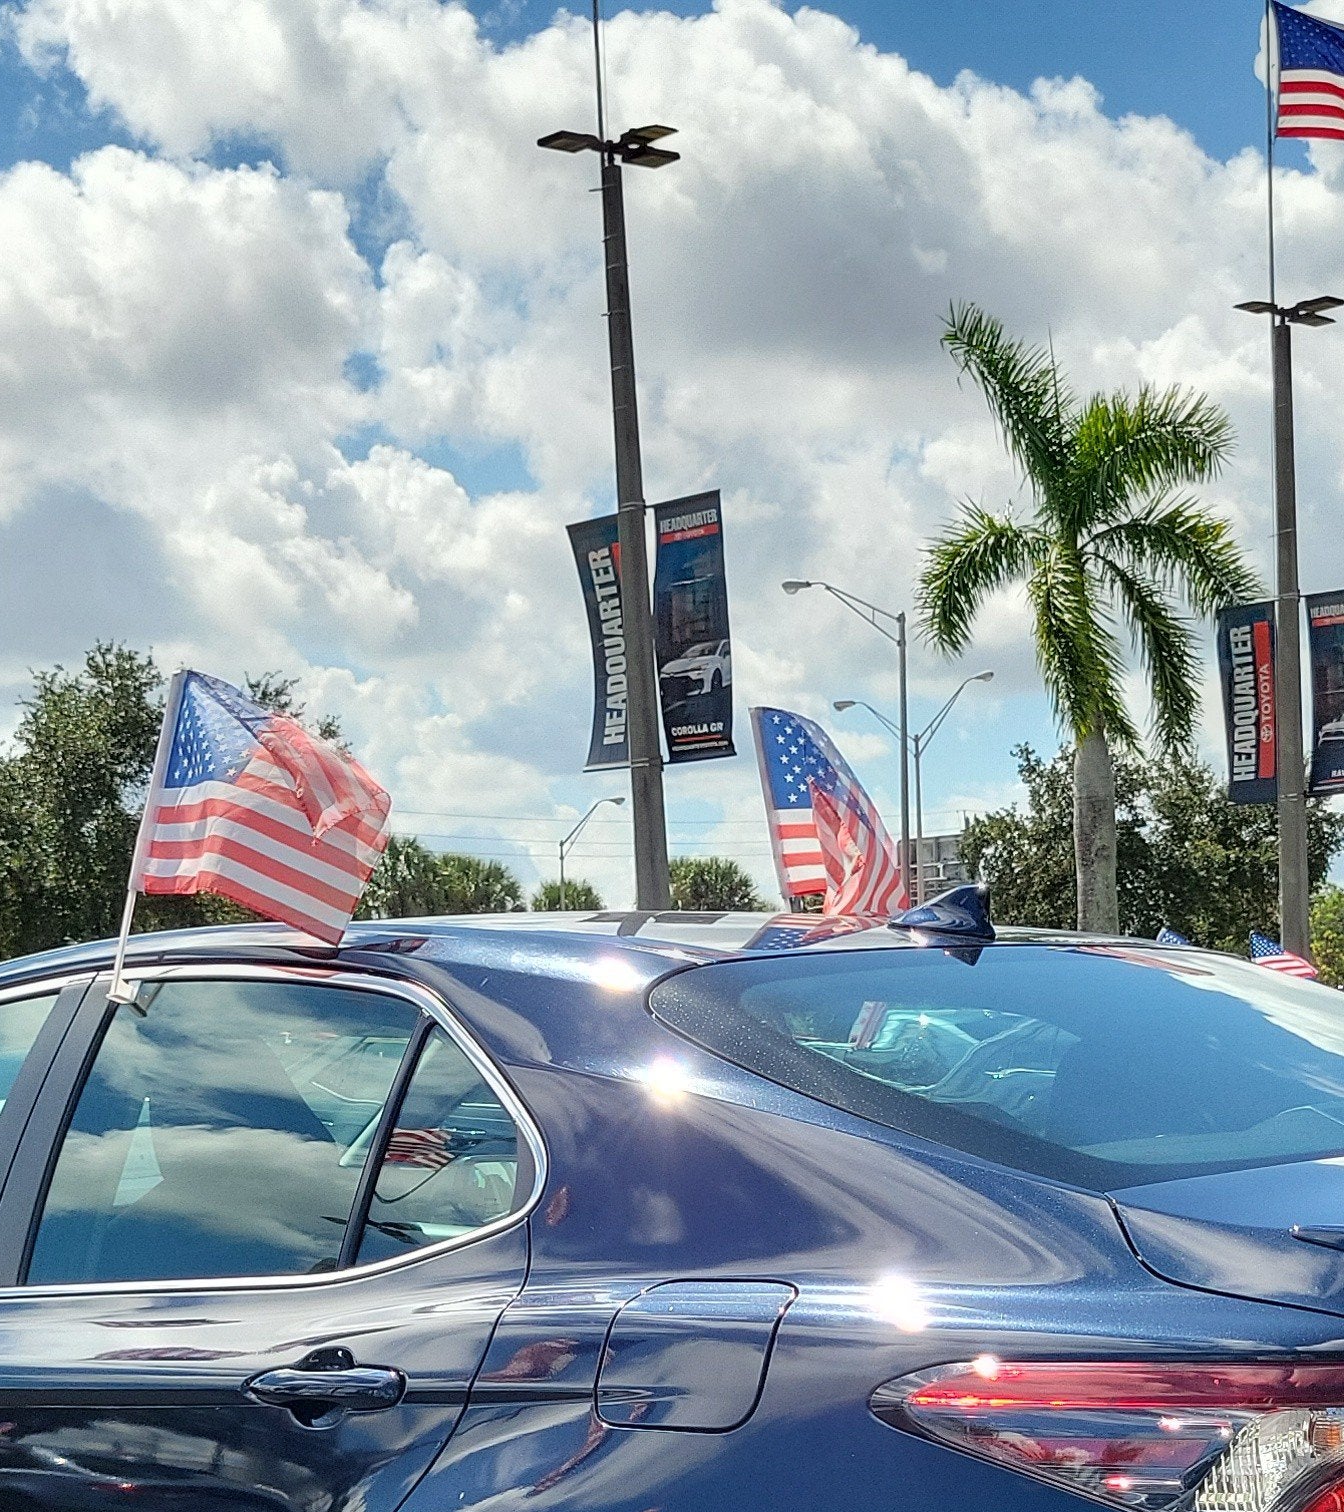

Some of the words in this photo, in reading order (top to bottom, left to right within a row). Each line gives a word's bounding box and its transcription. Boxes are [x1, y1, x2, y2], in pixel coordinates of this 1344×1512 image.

[660, 509, 717, 534] HEADQUARTER
[588, 546, 627, 746] HEADQUARTER
[1229, 625, 1259, 782] HEADQUARTER
[1258, 664, 1272, 722] TOYOTA
[671, 723, 709, 736] COROLLA
[709, 721, 724, 732] GR
